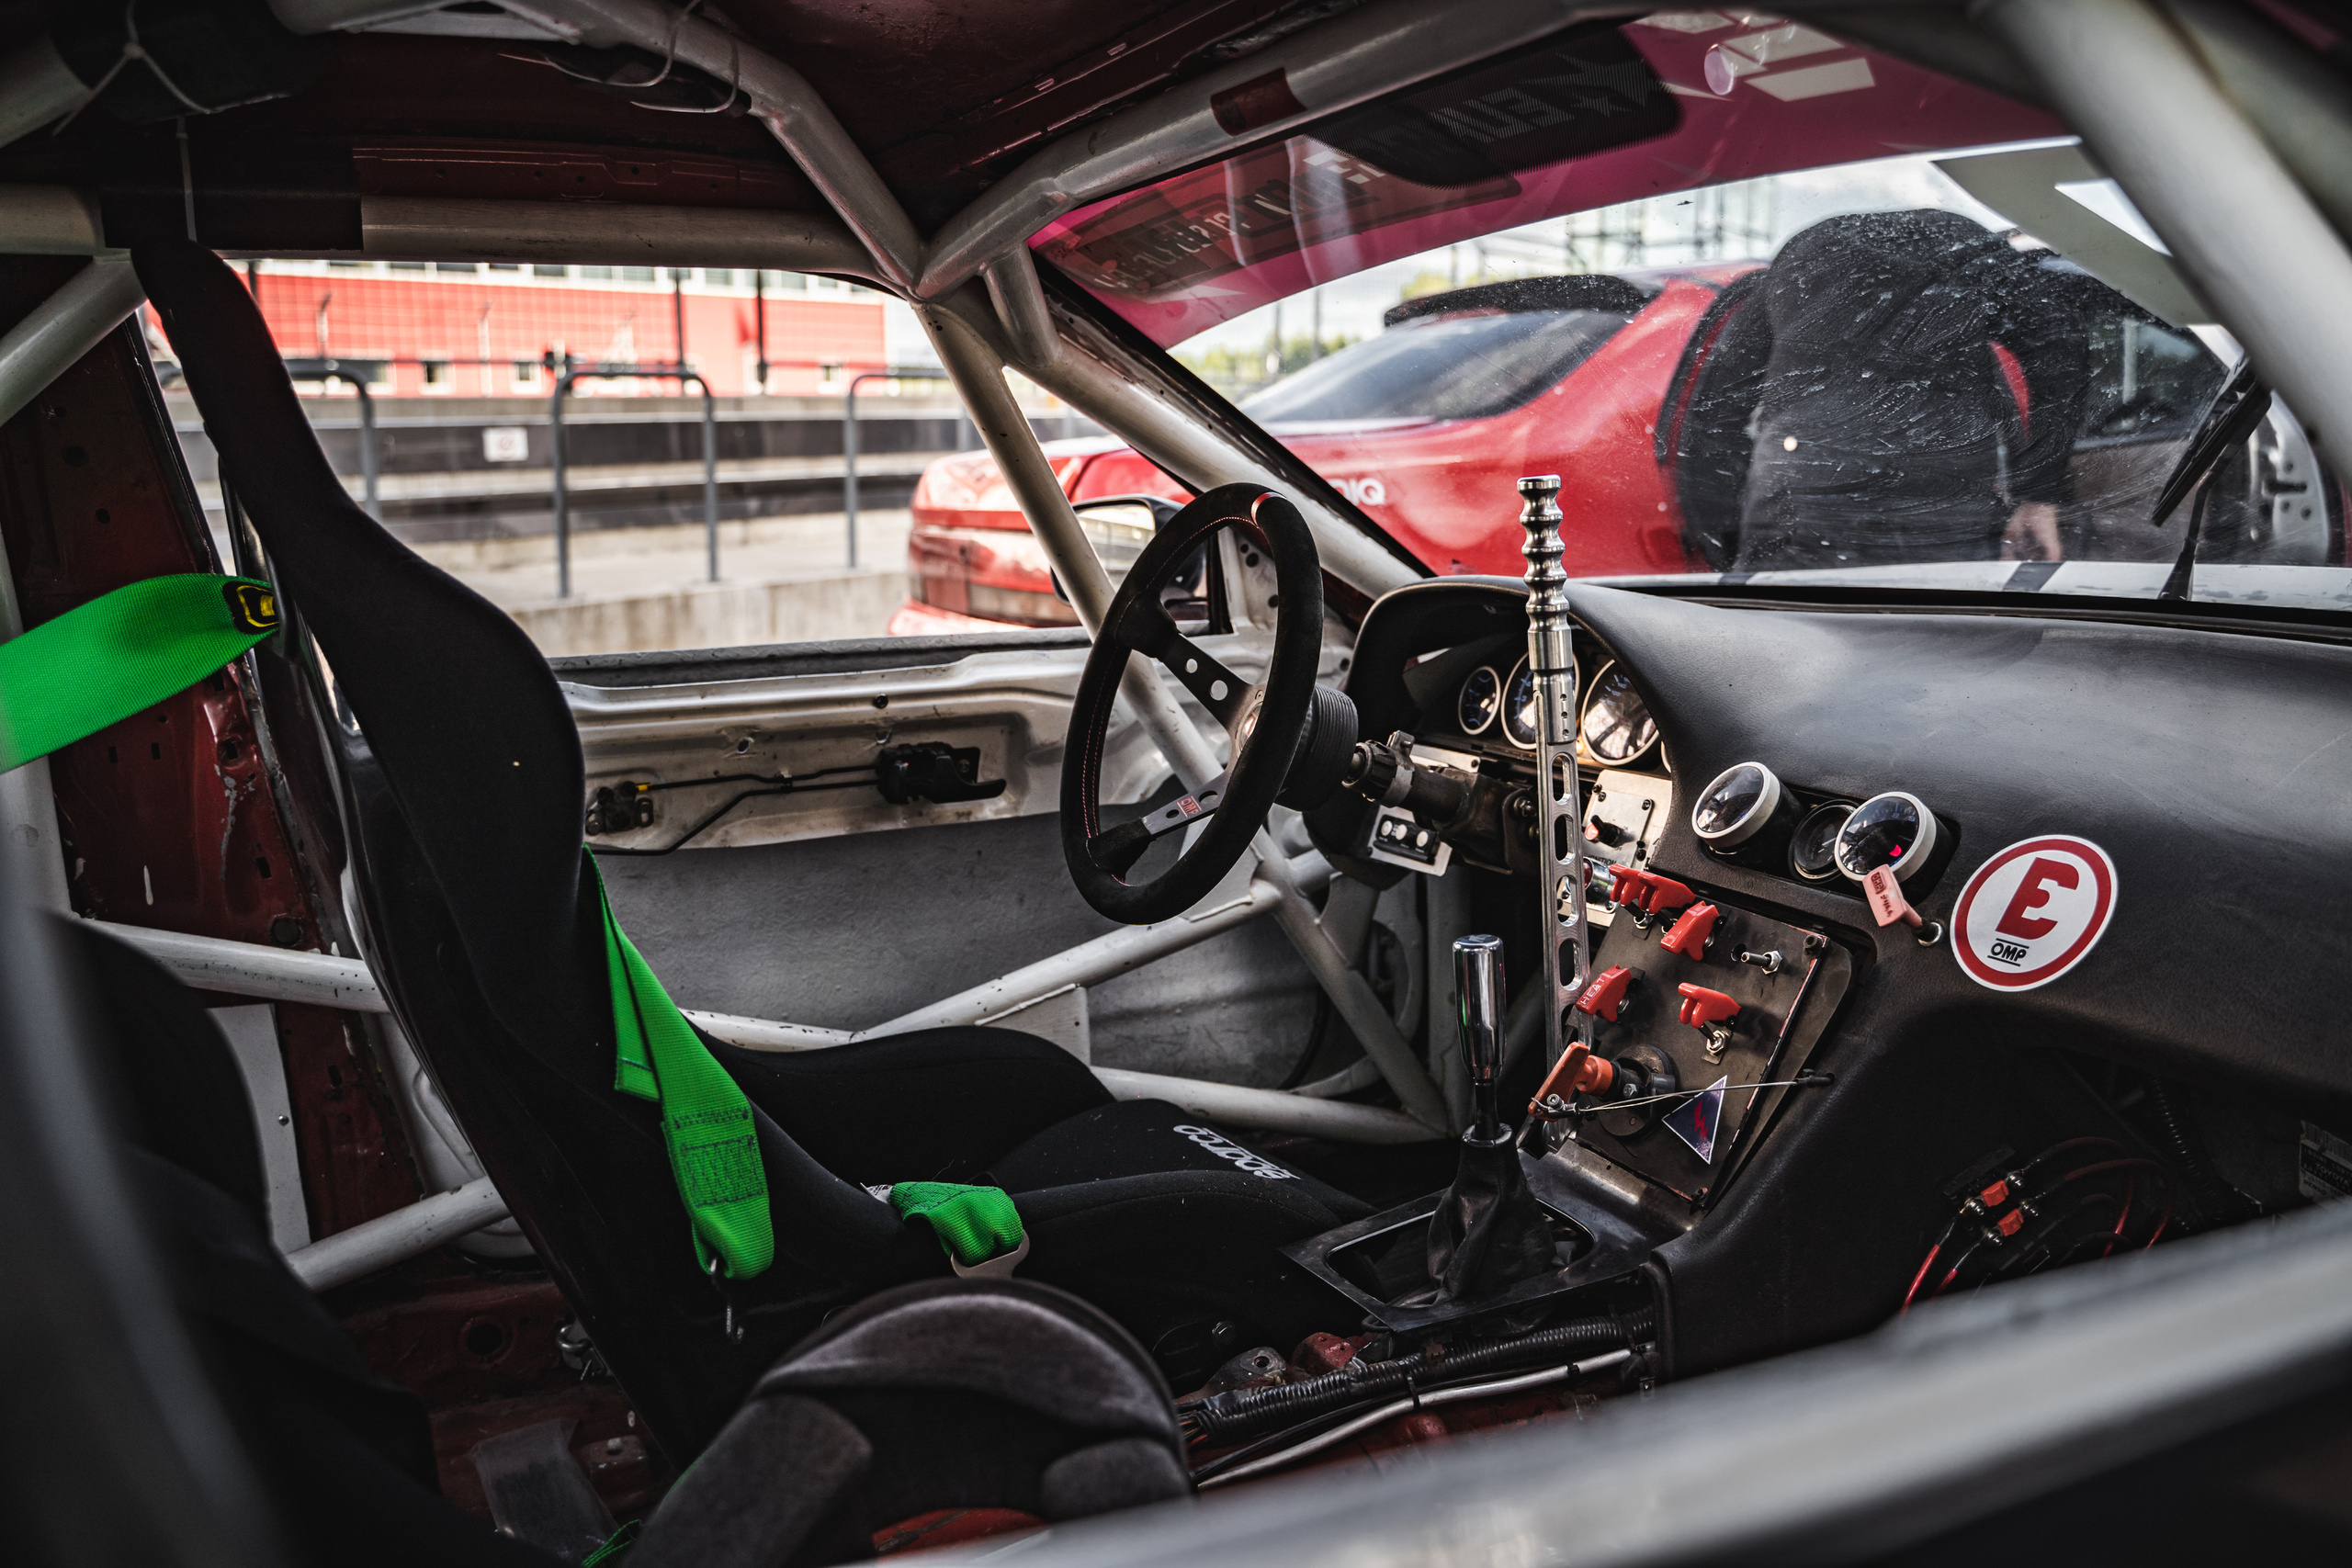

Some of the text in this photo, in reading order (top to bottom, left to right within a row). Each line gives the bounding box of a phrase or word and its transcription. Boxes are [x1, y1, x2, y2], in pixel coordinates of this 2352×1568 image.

[1995, 857, 2079, 940] E
[1990, 942, 2027, 962] OMP
[1579, 976, 1605, 1005] HEAT
[2315, 1162, 2350, 1187] TOYOTA
